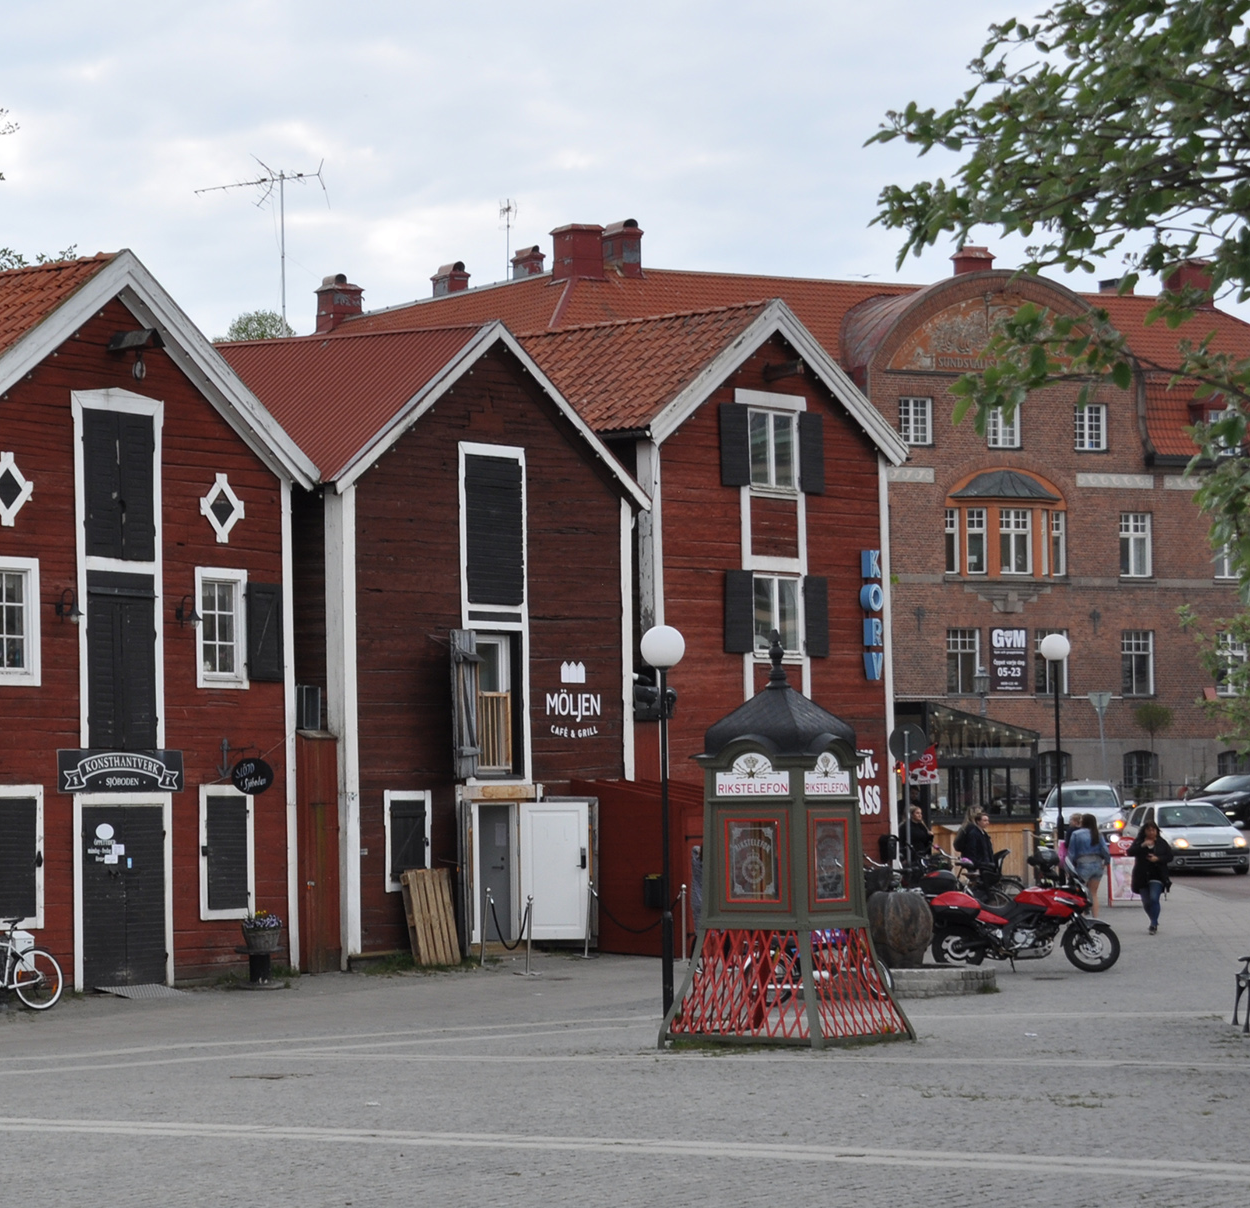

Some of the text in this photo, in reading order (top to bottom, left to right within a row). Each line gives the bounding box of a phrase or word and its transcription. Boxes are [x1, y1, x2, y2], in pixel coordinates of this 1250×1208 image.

[860, 549, 884, 681] KORV
[992, 628, 1026, 648] GYM
[997, 667, 1022, 678] 05-23
[545, 688, 601, 723] MÖLJEN
[550, 724, 599, 739] CAFÉ & GRILL
[84, 755, 160, 775] KONSTHANTVERK
[105, 776, 140, 788] SJÖBODEN
[717, 783, 789, 794] RIKSTELEFON
[804, 782, 850, 794] RIKSTELEFON
